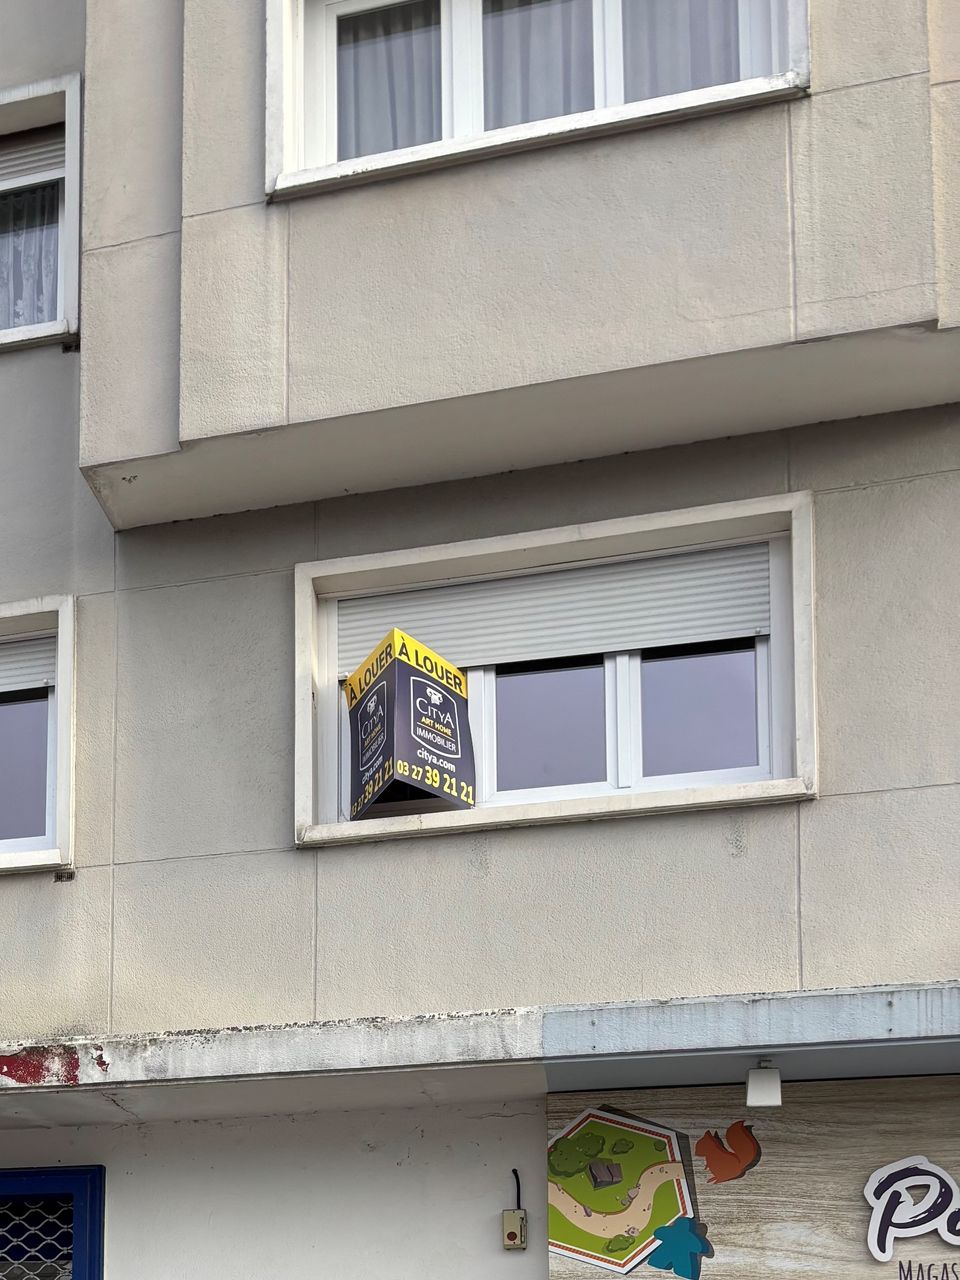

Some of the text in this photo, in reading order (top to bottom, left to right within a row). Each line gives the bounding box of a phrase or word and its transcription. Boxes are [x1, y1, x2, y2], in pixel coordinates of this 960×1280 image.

[348, 642, 393, 707] À LOUER
[398, 635, 464, 695] À LOUER
[416, 697, 455, 729] CITYA
[421, 716, 452, 737] ART HOME
[416, 726, 457, 753] IMMOBILIER
[364, 779, 374, 804] 39
[374, 768, 384, 793] 21
[384, 756, 394, 782] 21
[416, 748, 456, 773] citya.com
[396, 759, 475, 805] 03 27 39 21 21
